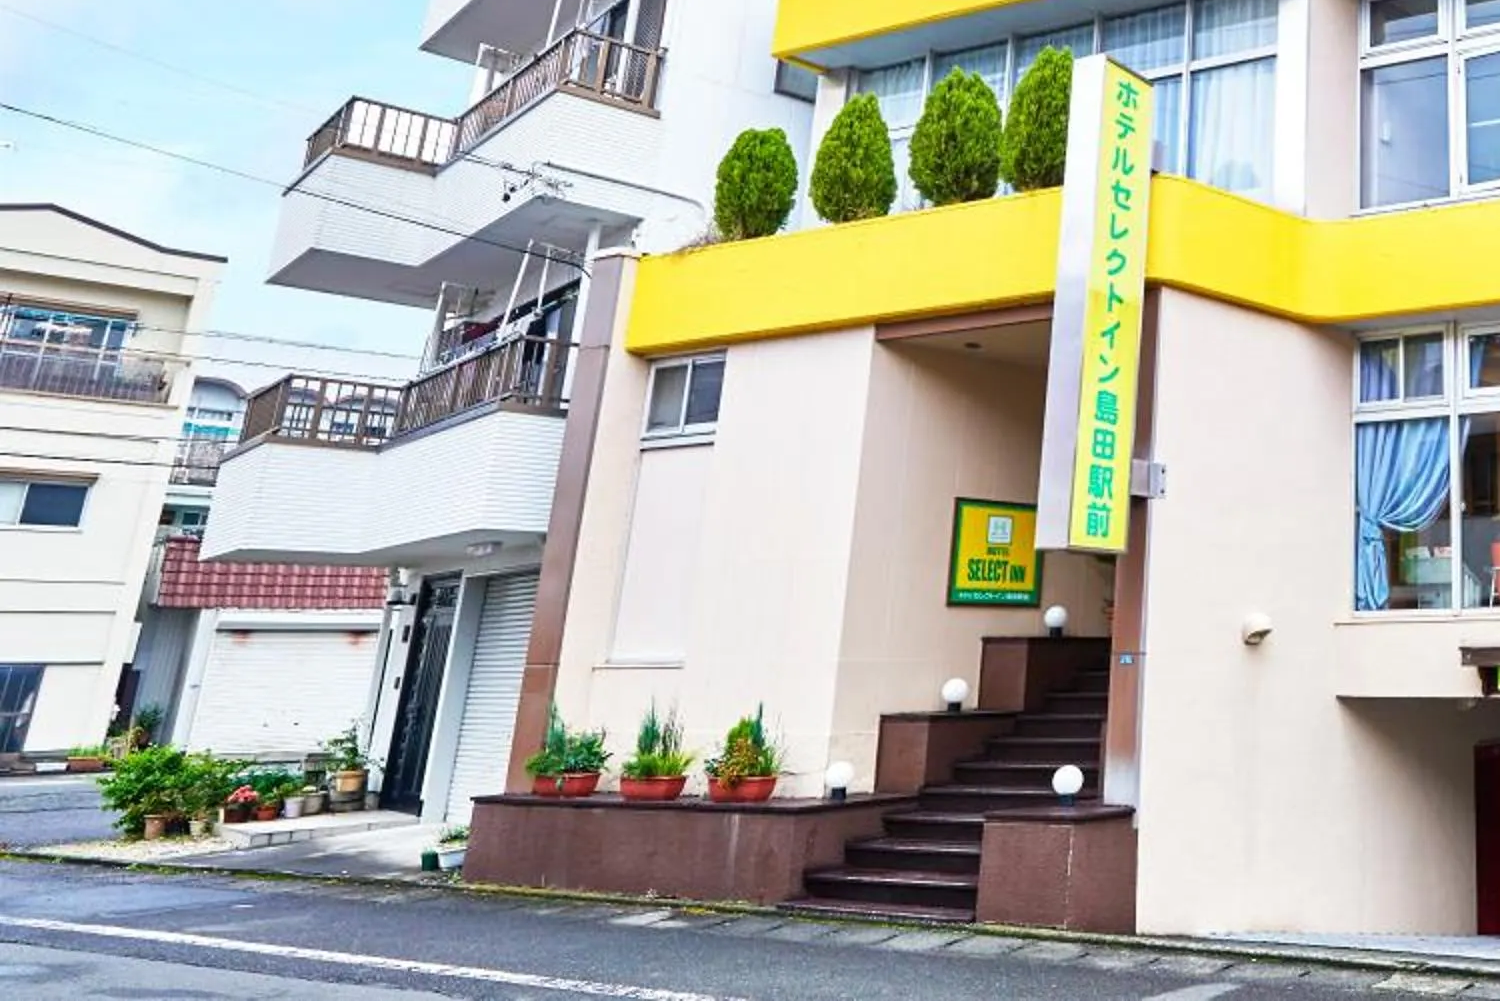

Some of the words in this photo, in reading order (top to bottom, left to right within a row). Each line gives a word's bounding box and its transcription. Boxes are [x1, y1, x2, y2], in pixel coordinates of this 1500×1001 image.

[1086, 81, 1140, 538] ホテルセレクトイン島田駅前
[967, 558, 1009, 583] SELECT
[1009, 564, 1027, 584] INN
